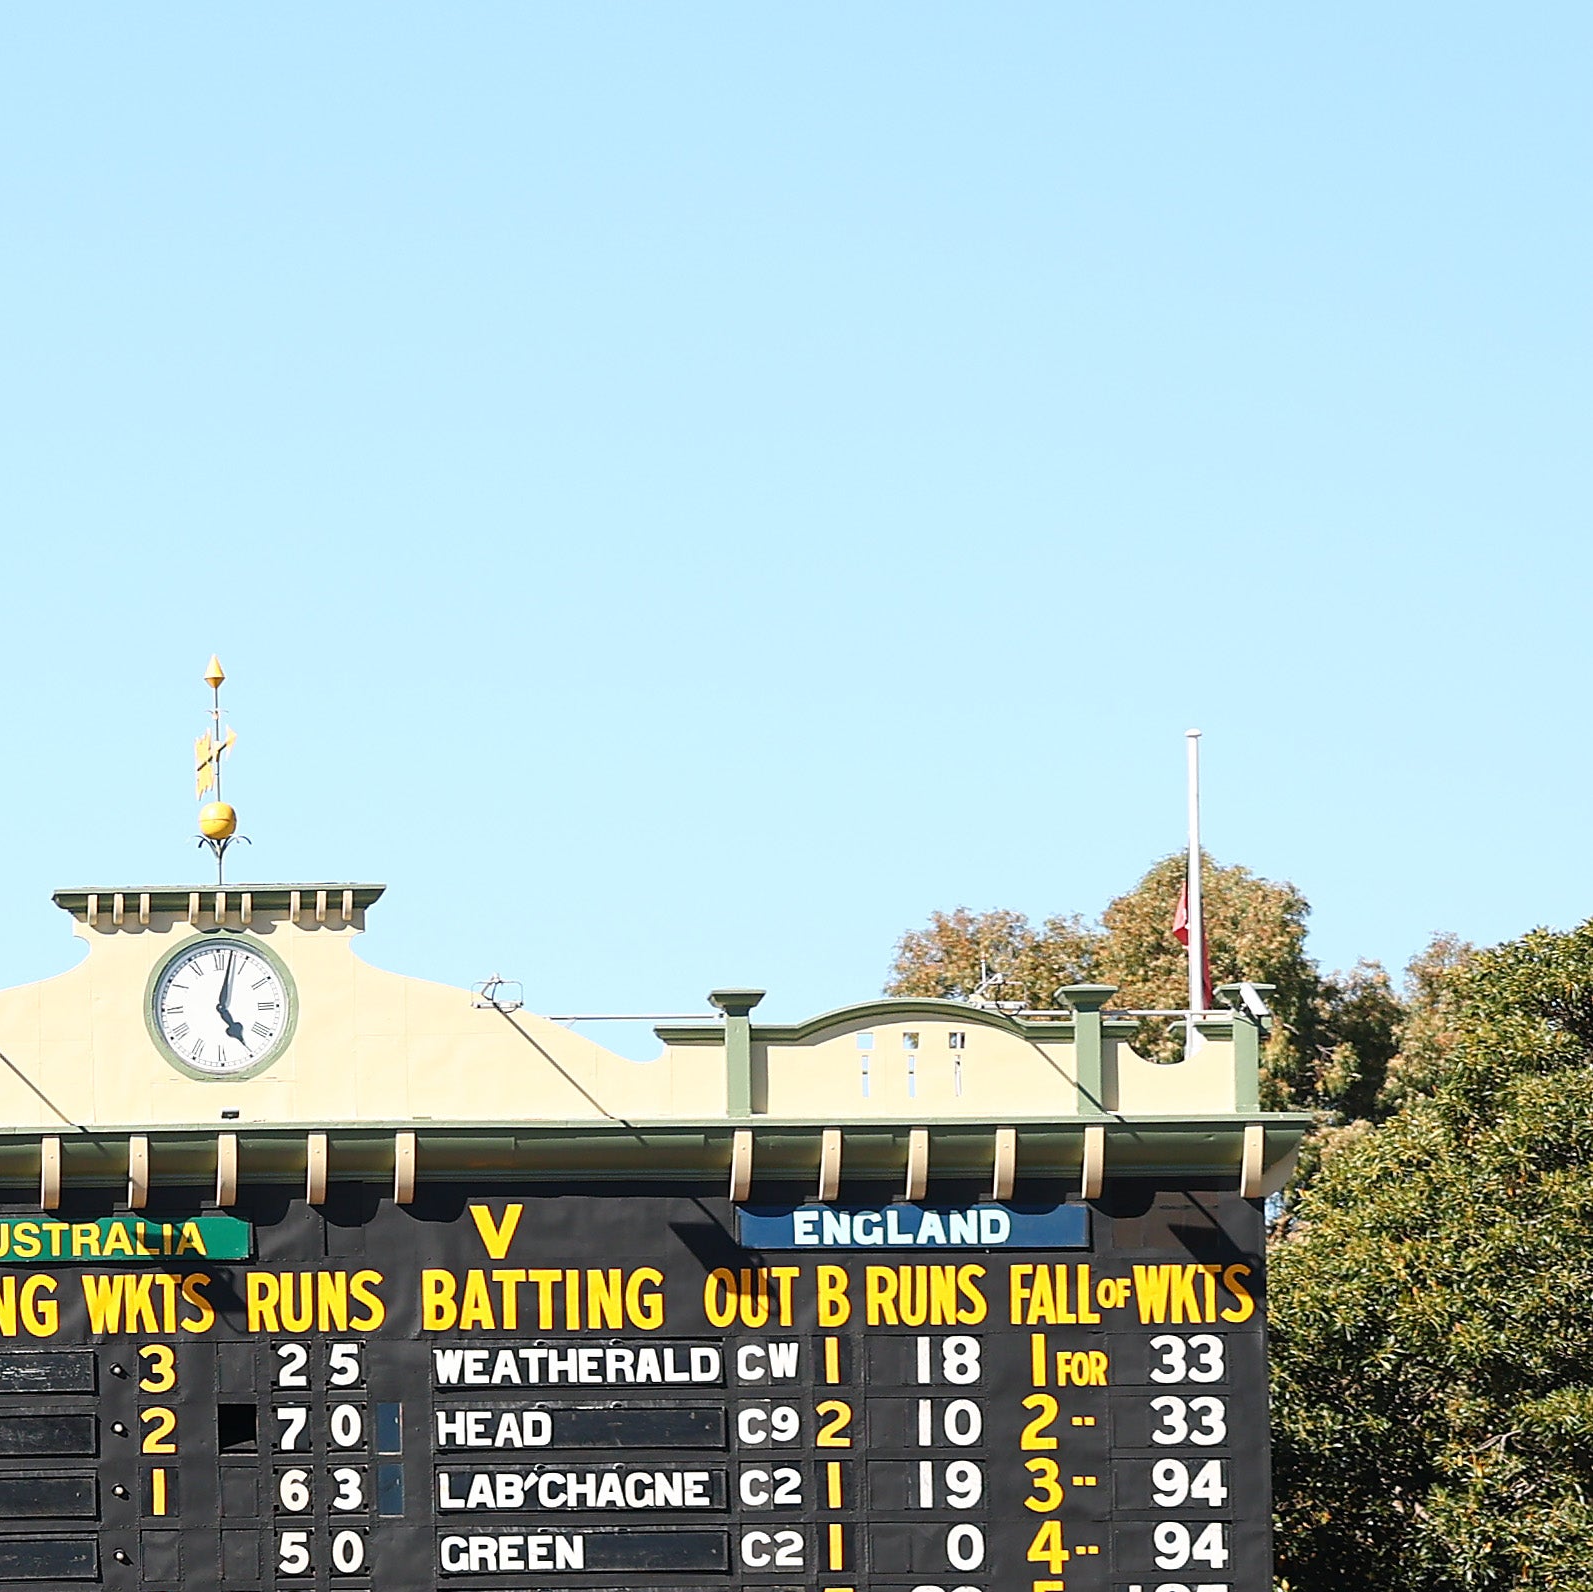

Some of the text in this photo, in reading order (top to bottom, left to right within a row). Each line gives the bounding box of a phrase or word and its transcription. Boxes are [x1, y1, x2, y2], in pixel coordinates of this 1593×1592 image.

[469, 1203, 524, 1260] V
[792, 1209, 1012, 1246] ENGLAND
[81, 1272, 216, 1335] WKTS
[247, 1270, 386, 1334] RUNS
[421, 1263, 1256, 1331] BATTING OUT B RUNS FALL OF WKTS
[433, 1334, 1225, 1388] WEATHERALD 18 FOR 33
[436, 1395, 1227, 1448] HEAD 10 33
[439, 1458, 1229, 1509] LAB'CHAGNE 19 94
[439, 1521, 1229, 1572] GREEN 94
